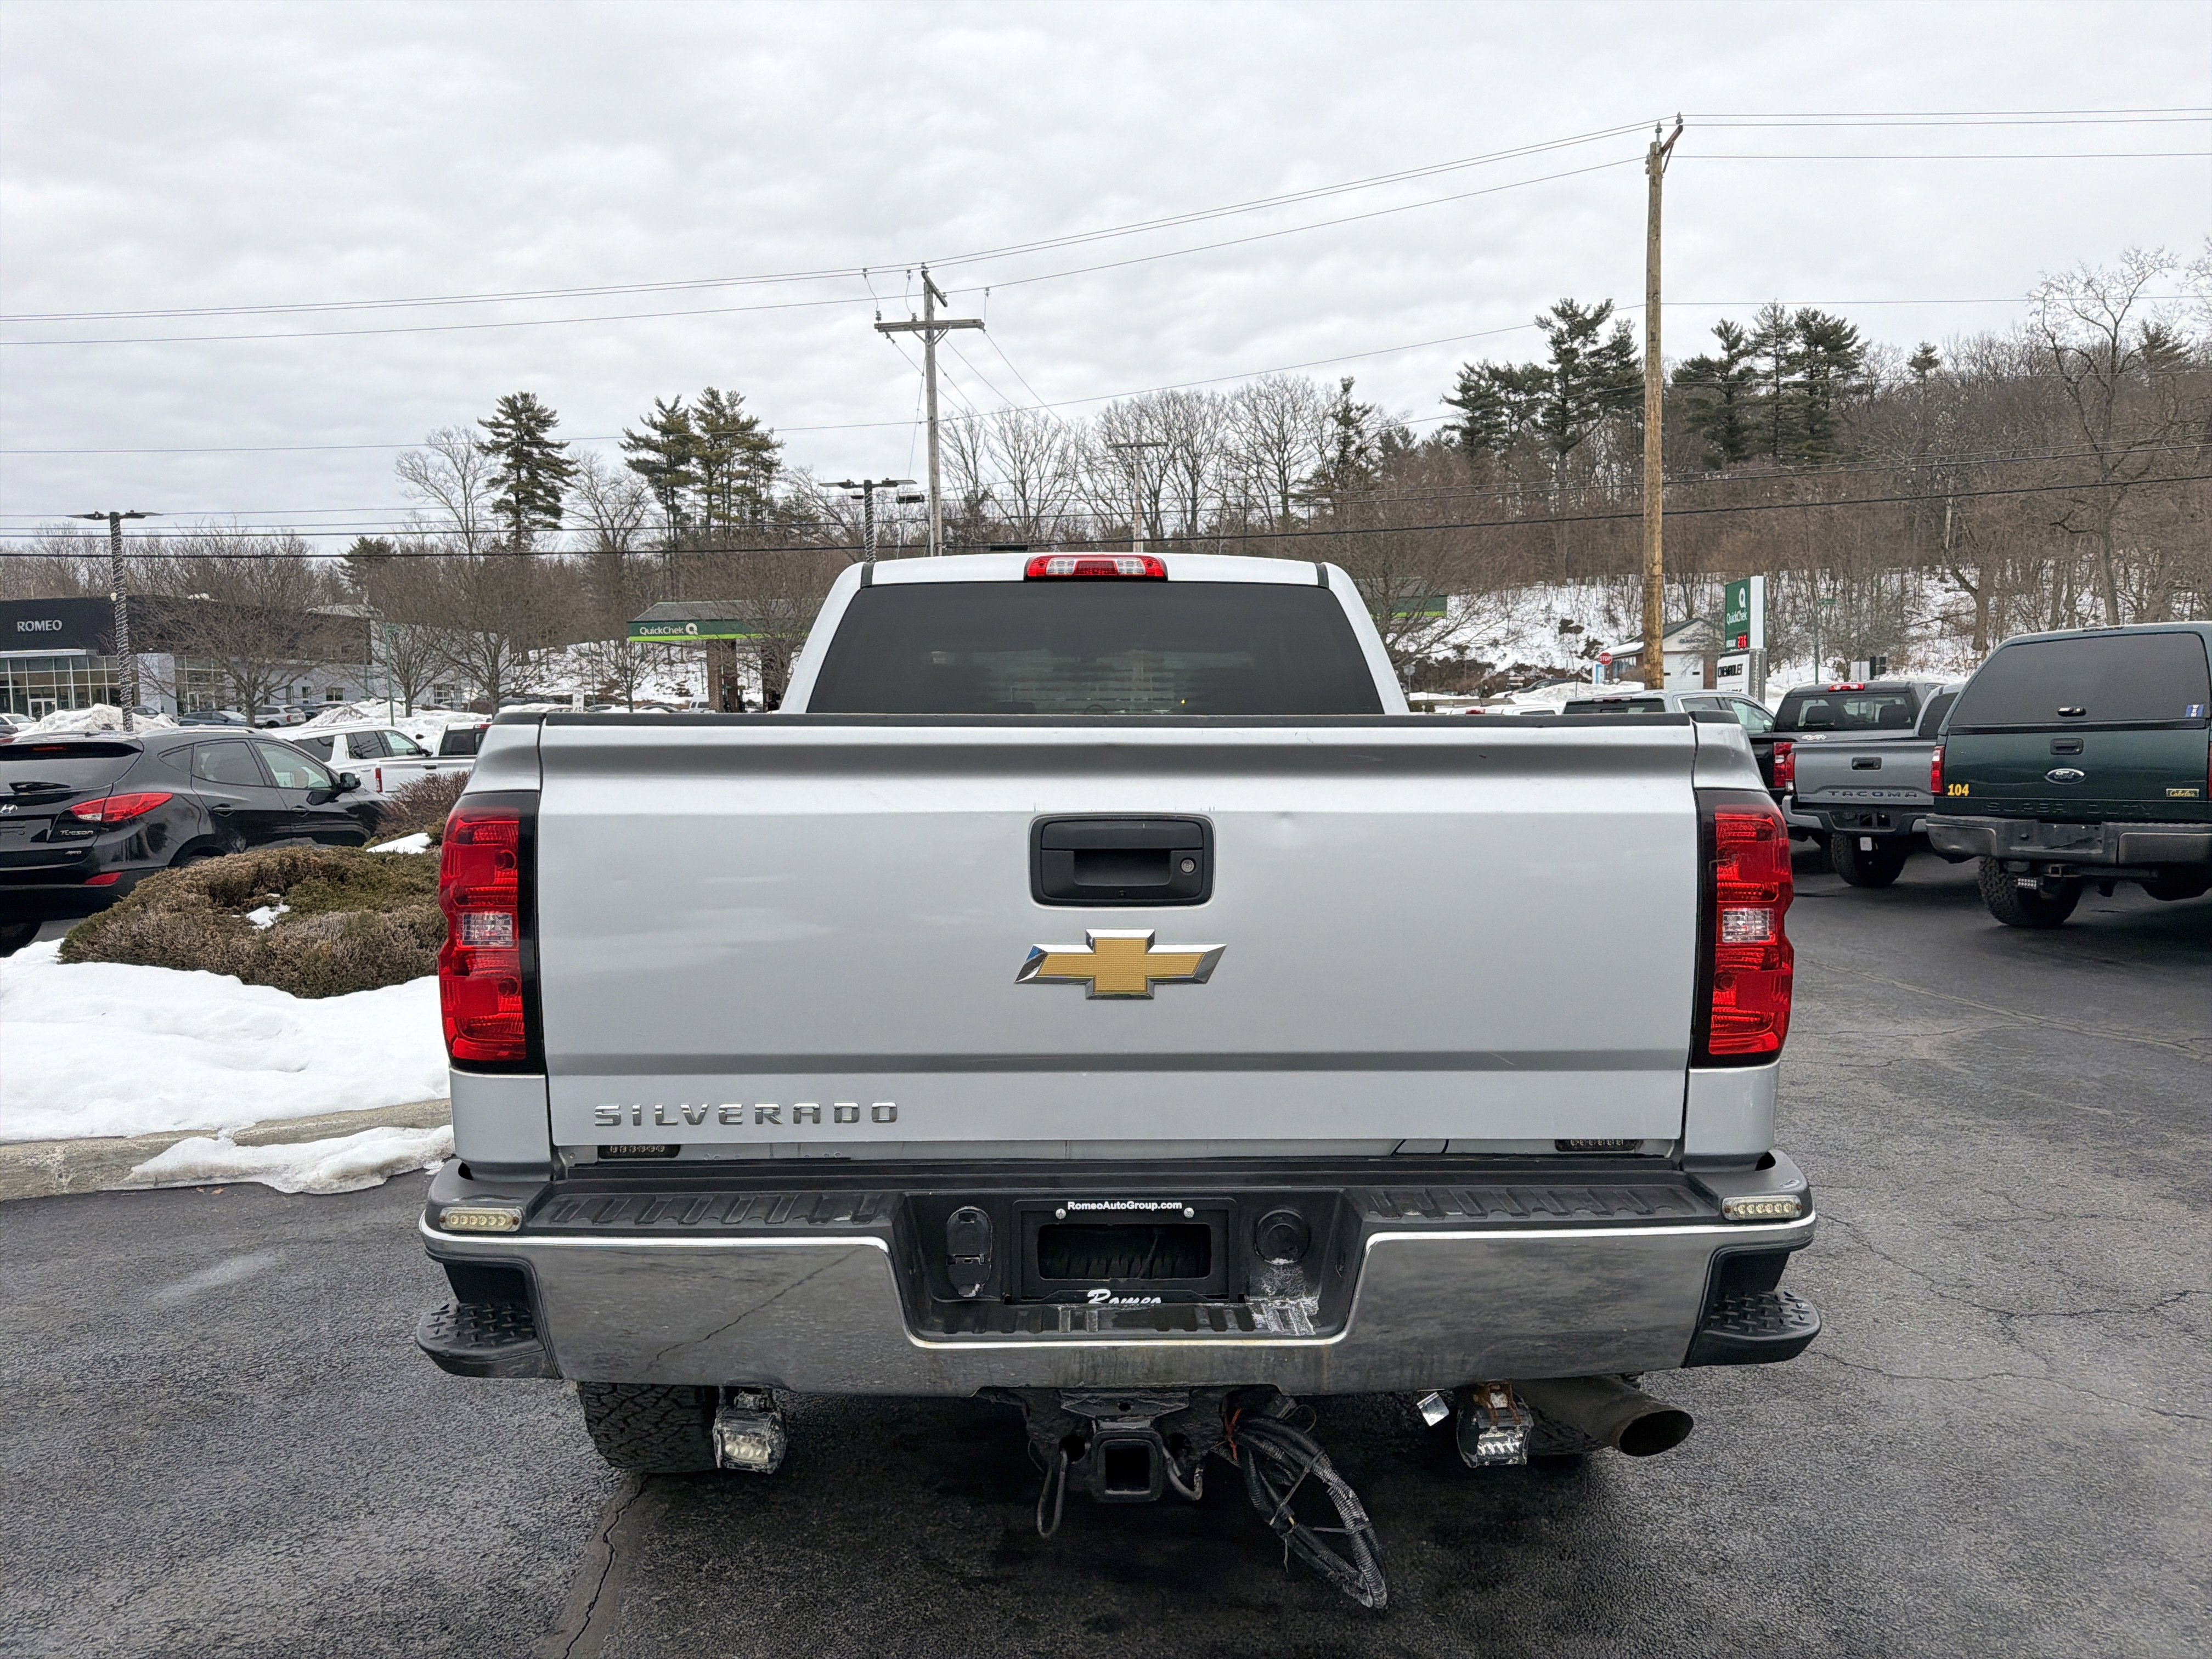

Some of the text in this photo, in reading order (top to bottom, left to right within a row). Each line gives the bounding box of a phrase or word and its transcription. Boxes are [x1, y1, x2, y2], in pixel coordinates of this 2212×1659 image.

[17, 619, 63, 632] ROMEO
[640, 626, 684, 635] QuickChek
[1948, 783, 1969, 796] 104
[594, 1102, 898, 1126] SILVERADO
[1068, 1201, 1182, 1211] RomeoAutoGroup.com
